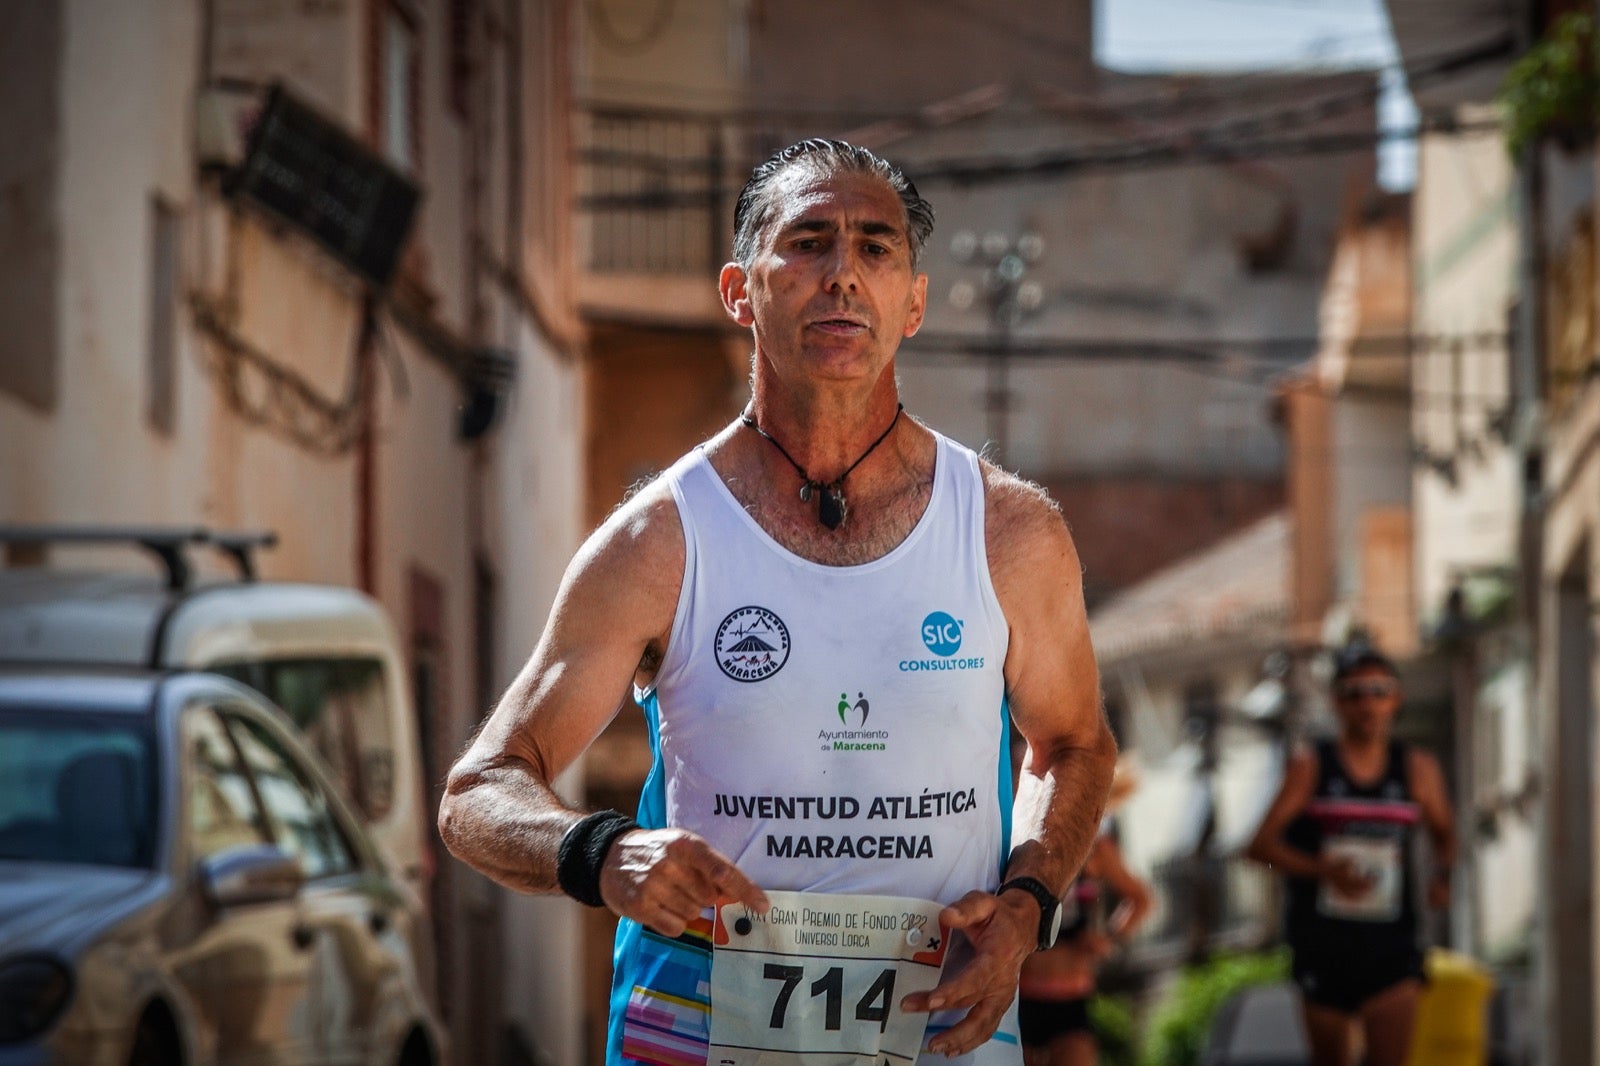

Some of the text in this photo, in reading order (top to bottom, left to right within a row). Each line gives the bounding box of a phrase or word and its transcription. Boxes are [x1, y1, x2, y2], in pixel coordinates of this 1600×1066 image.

[923, 622, 961, 645] SIC
[723, 659, 779, 679] MARACENA
[899, 658, 985, 671] CONSULTORES
[818, 729, 889, 741] Ayuntamiento
[833, 741, 886, 751] Maracena
[713, 788, 977, 820] JUVENTUD ATLÉTICA
[766, 835, 934, 859] MARACENA
[901, 912, 928, 932] 2022
[763, 963, 897, 1034] 714
